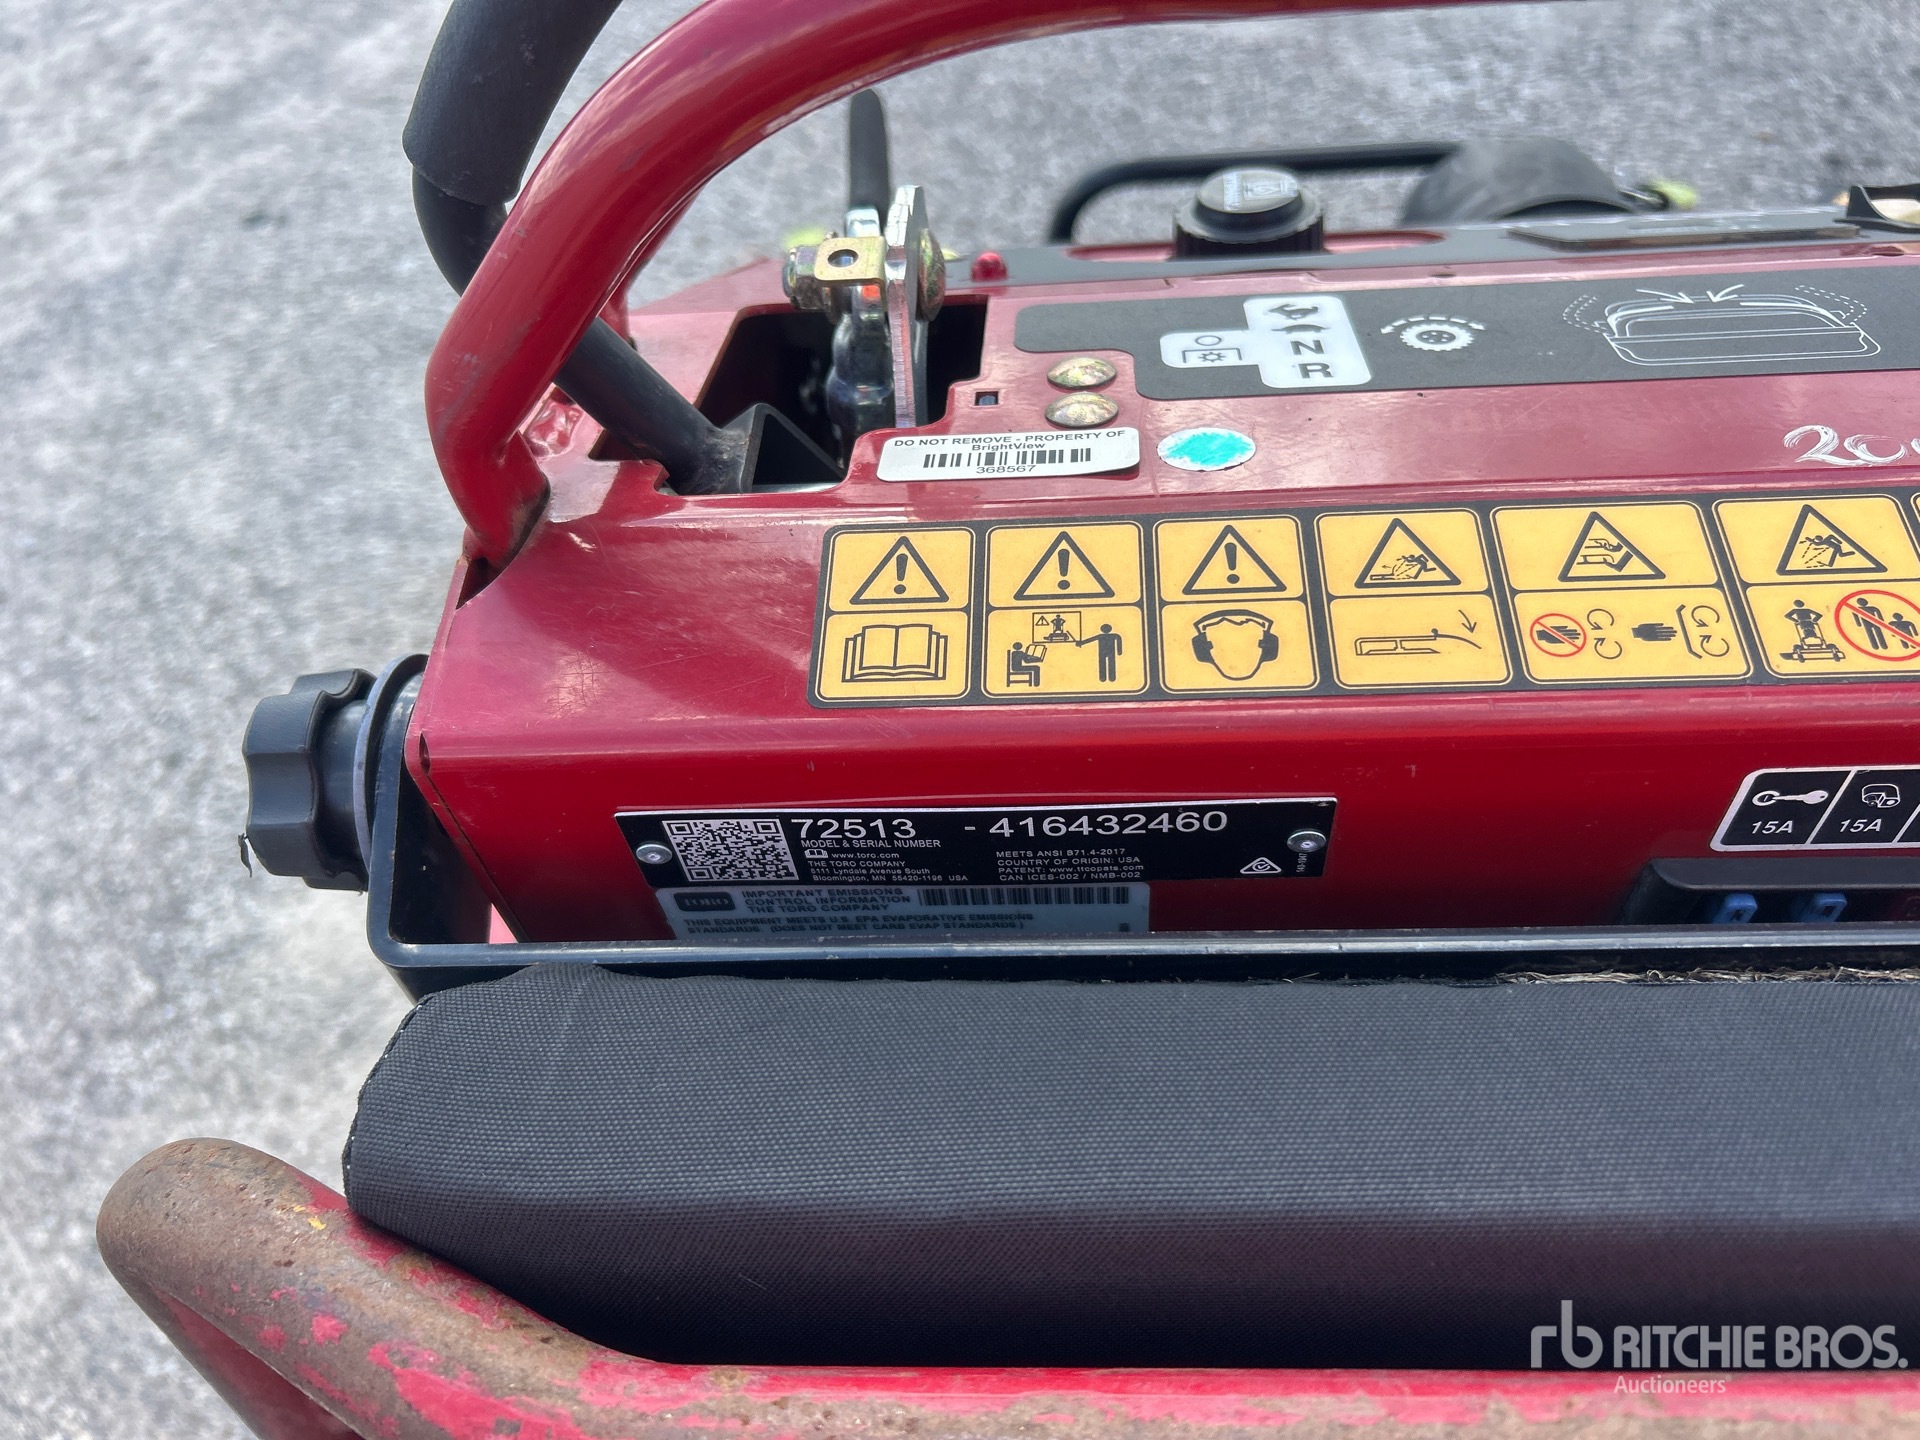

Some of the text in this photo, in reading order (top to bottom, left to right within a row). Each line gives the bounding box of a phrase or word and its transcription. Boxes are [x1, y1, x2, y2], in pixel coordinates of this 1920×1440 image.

[1290, 339, 1325, 355] N
[1298, 362, 1333, 379] R
[894, 439, 914, 447] DO
[916, 438, 948, 446] NOT
[952, 436, 1011, 445] REMOVE
[1025, 433, 1101, 442] PROPERTY
[972, 442, 1045, 451] BrightView
[976, 465, 1036, 474] 368567
[791, 818, 916, 839] 72513
[989, 810, 1228, 838] 416432460
[1751, 820, 1794, 835] 15A
[1839, 818, 1882, 833] 15A
[801, 840, 941, 848] MODEL & SERIAL NUMBER
[996, 850, 1033, 858] MEETS
[1066, 848, 1126, 857] B71.4-2017
[1071, 857, 1114, 865] ORIGIN:
[1049, 864, 1144, 874] www.ttcopats.com
[1090, 871, 1141, 879] NMB-002
[741, 888, 904, 898] IMPORTANT EMISSIONS
[745, 896, 911, 906] CONTROL INFORMATION
[748, 904, 890, 913] THE TORO COMPANY
[714, 917, 782, 925] EQUIPMENT
